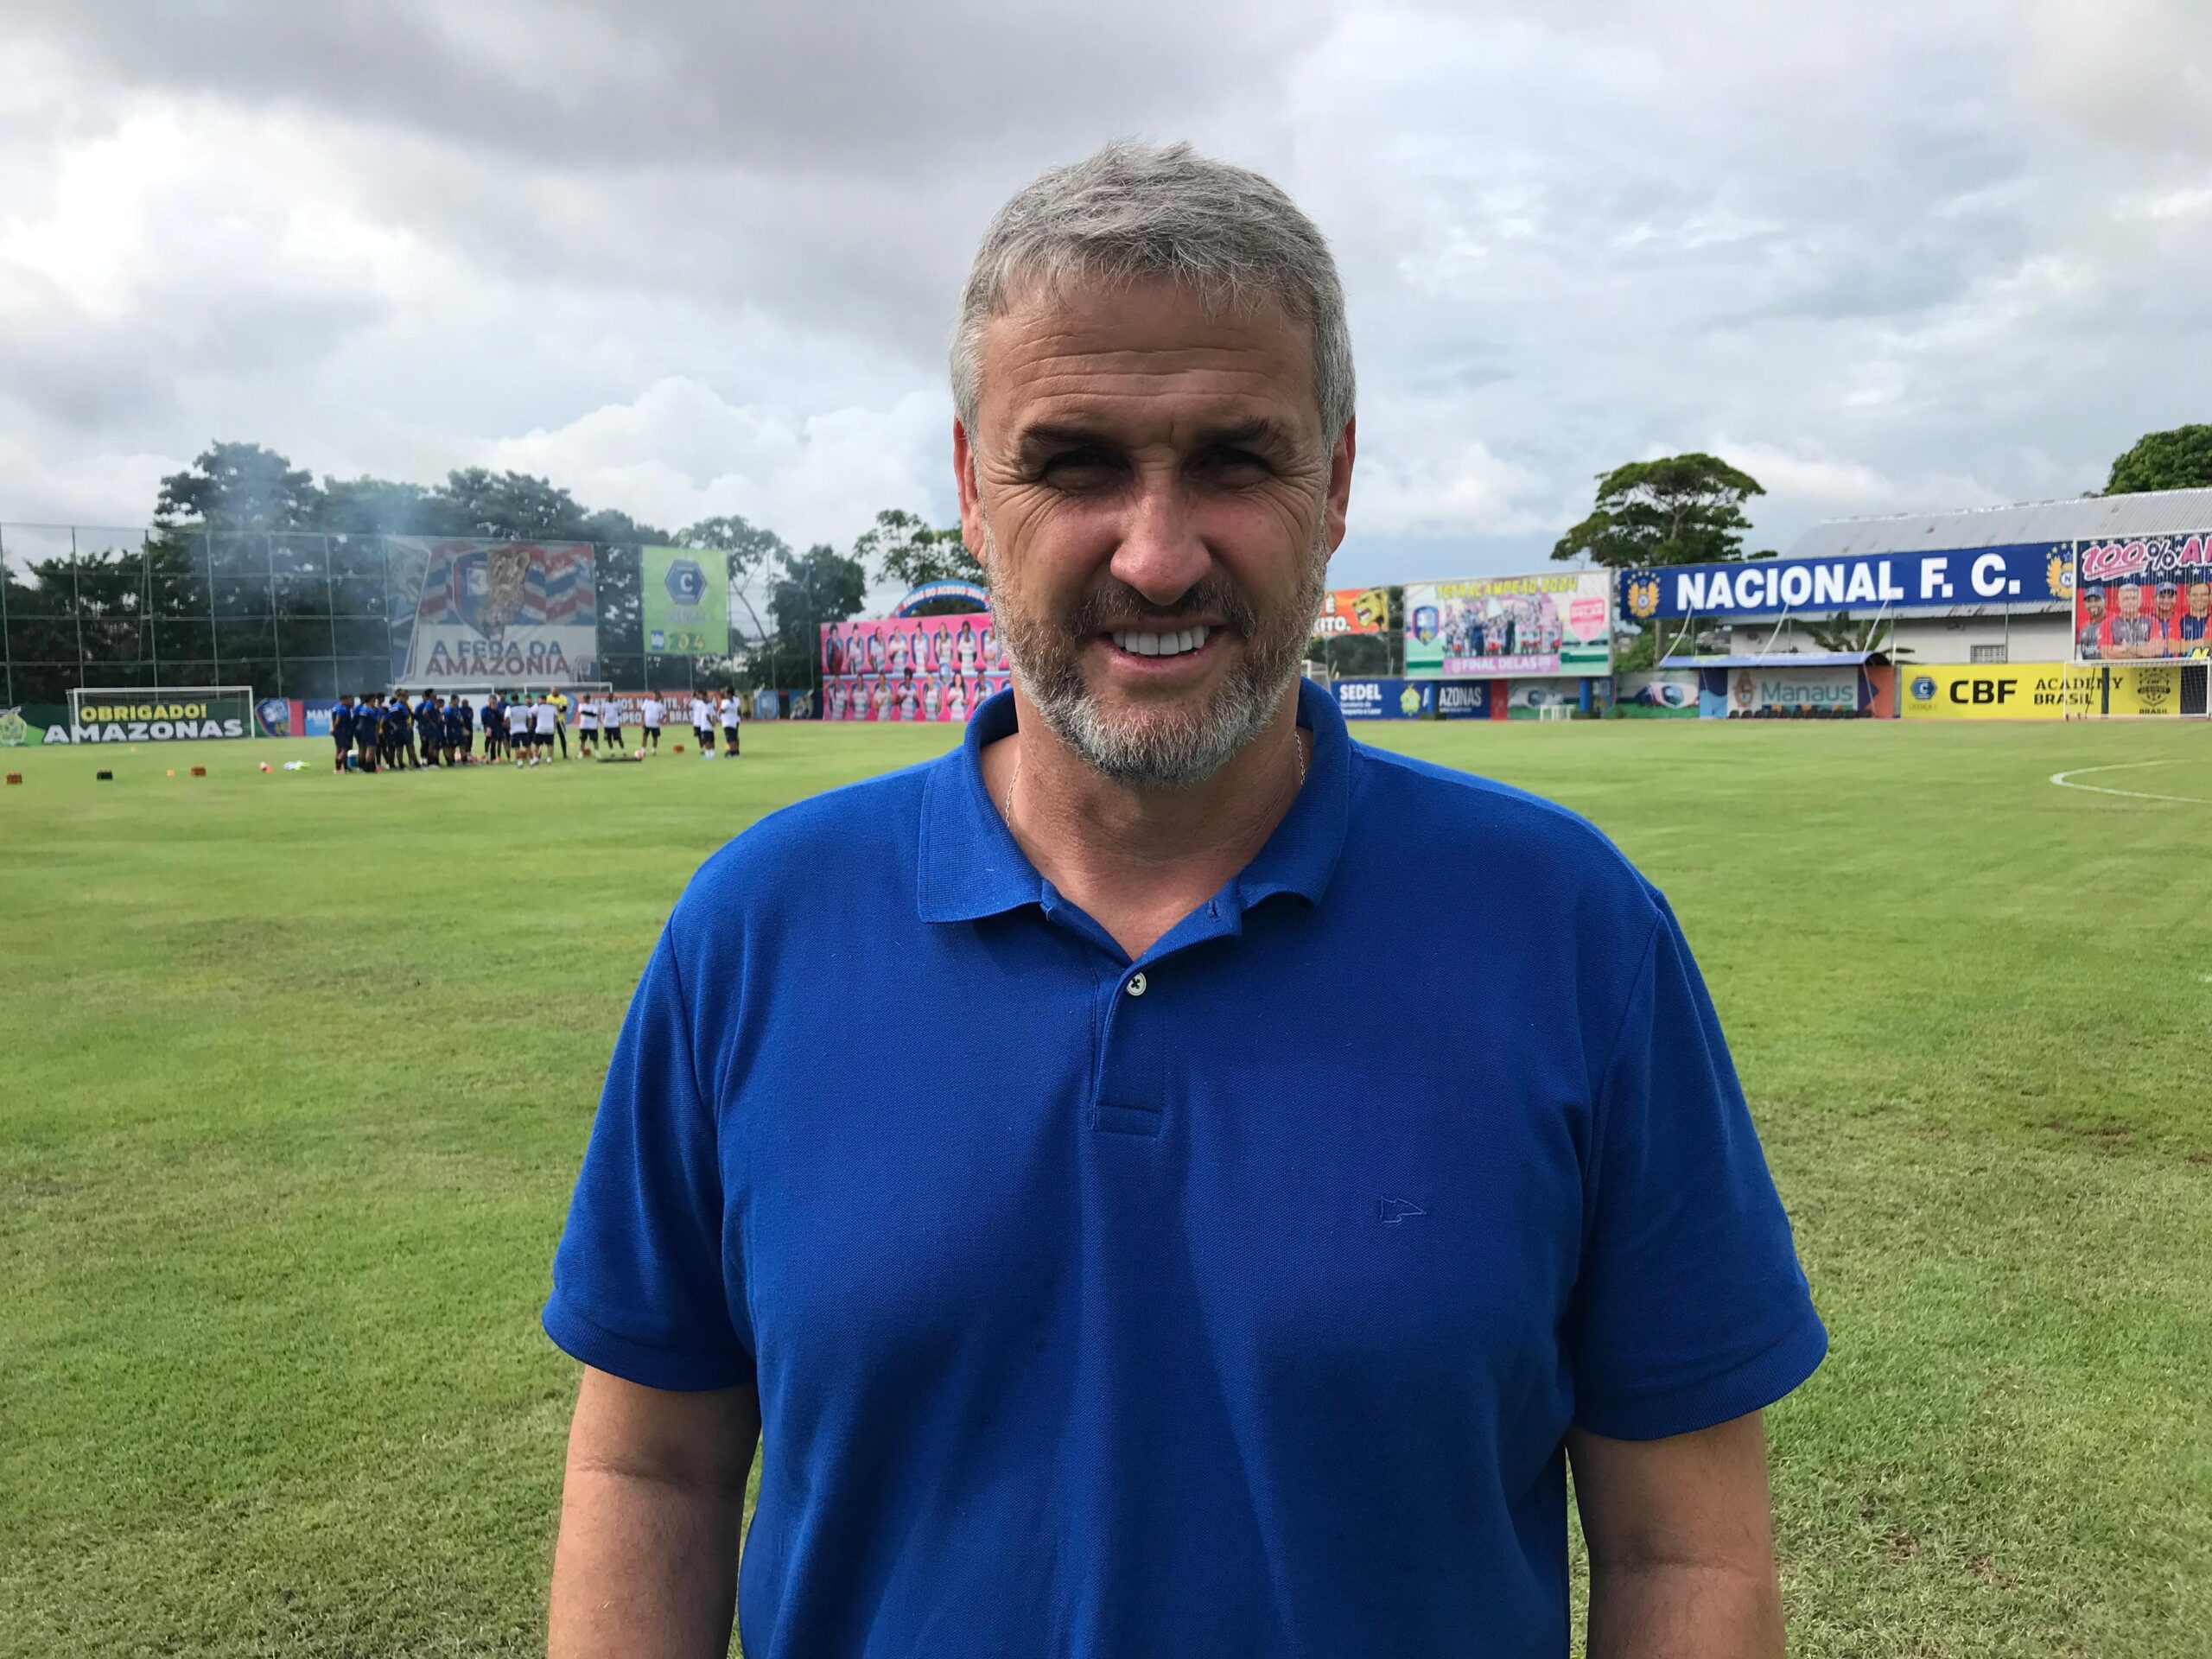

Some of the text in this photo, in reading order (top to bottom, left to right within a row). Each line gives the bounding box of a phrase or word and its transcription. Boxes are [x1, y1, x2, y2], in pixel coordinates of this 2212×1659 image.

[2082, 539, 2177, 580] 100%
[1676, 553, 2020, 610] NACIONAL F. C.
[1314, 616, 1351, 632] XITO.
[432, 639, 449, 657] A
[529, 639, 562, 658] DA
[1462, 657, 1496, 670] FINAL
[1498, 656, 1537, 670] DELAS
[1340, 683, 1382, 701] SEDEL
[1422, 687, 1482, 707] AAZONAS
[1761, 682, 1853, 702] Manaus
[1949, 679, 2018, 704] CBF
[2033, 693, 2094, 705] BRASIL
[80, 702, 207, 721] OBRIGADO!
[43, 719, 244, 744] AMAZONAS
